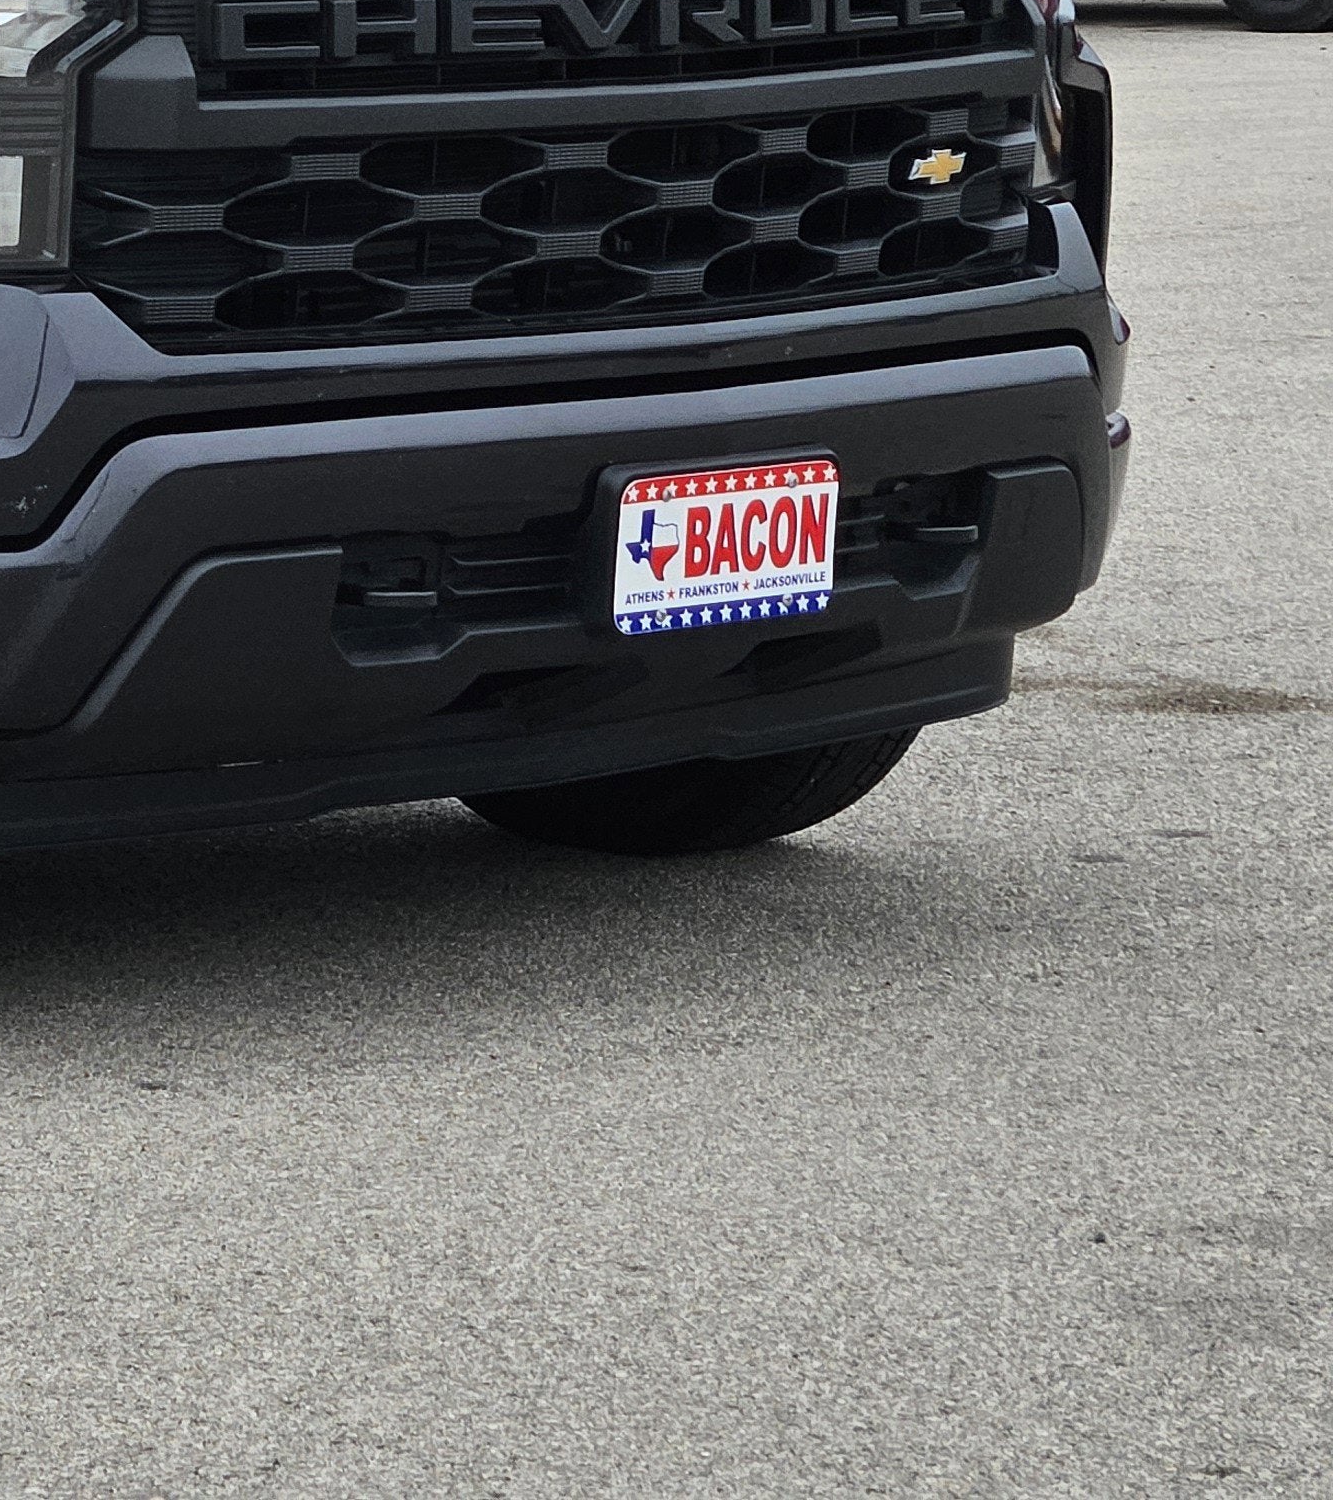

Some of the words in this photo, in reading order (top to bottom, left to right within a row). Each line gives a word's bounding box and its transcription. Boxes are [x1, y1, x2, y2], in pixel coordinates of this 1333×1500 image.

[683, 493, 830, 578] BACON
[625, 590, 665, 606] ATHENS
[678, 581, 739, 599] FRANKSTON
[753, 571, 826, 591] JACKSONVILLE
